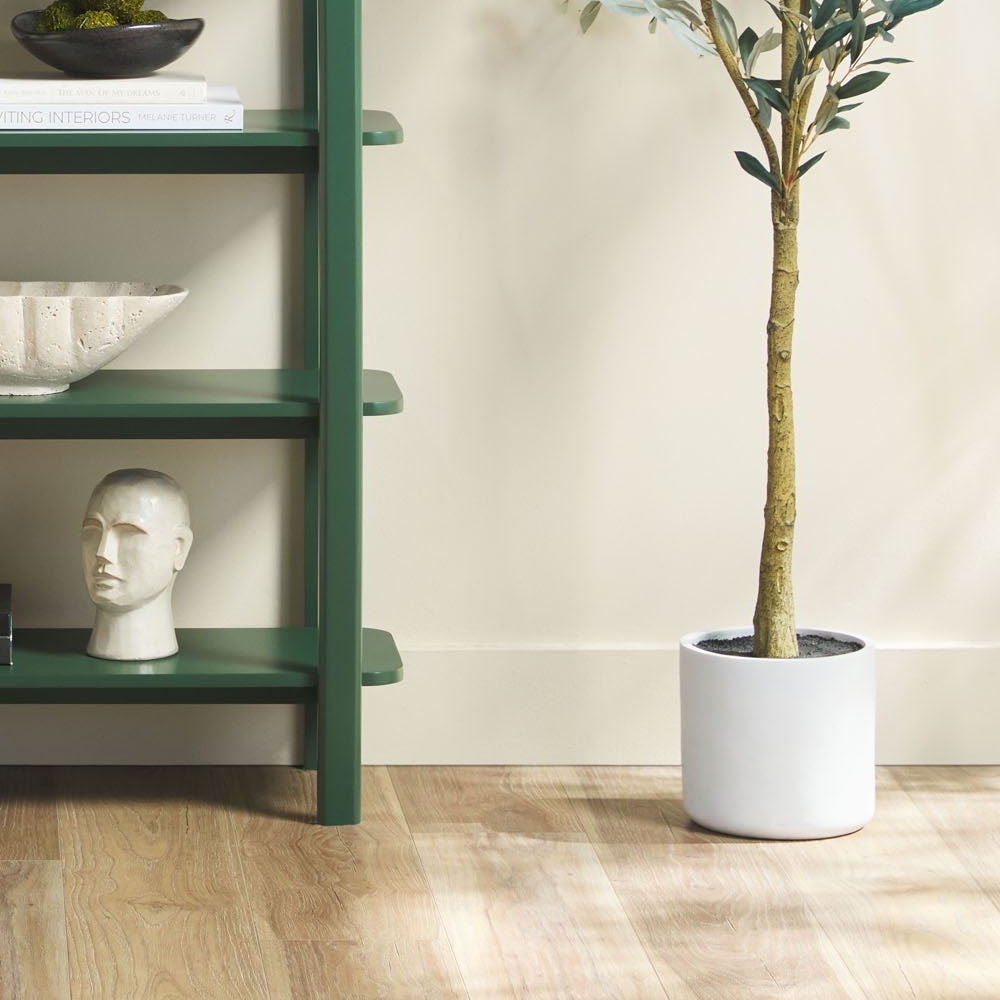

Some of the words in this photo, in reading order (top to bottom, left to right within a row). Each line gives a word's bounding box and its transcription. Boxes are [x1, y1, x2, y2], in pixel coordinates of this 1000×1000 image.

[49, 110, 131, 124] INTERIORS
[138, 112, 178, 121] MELANIE
[180, 112, 217, 121] TURNER
